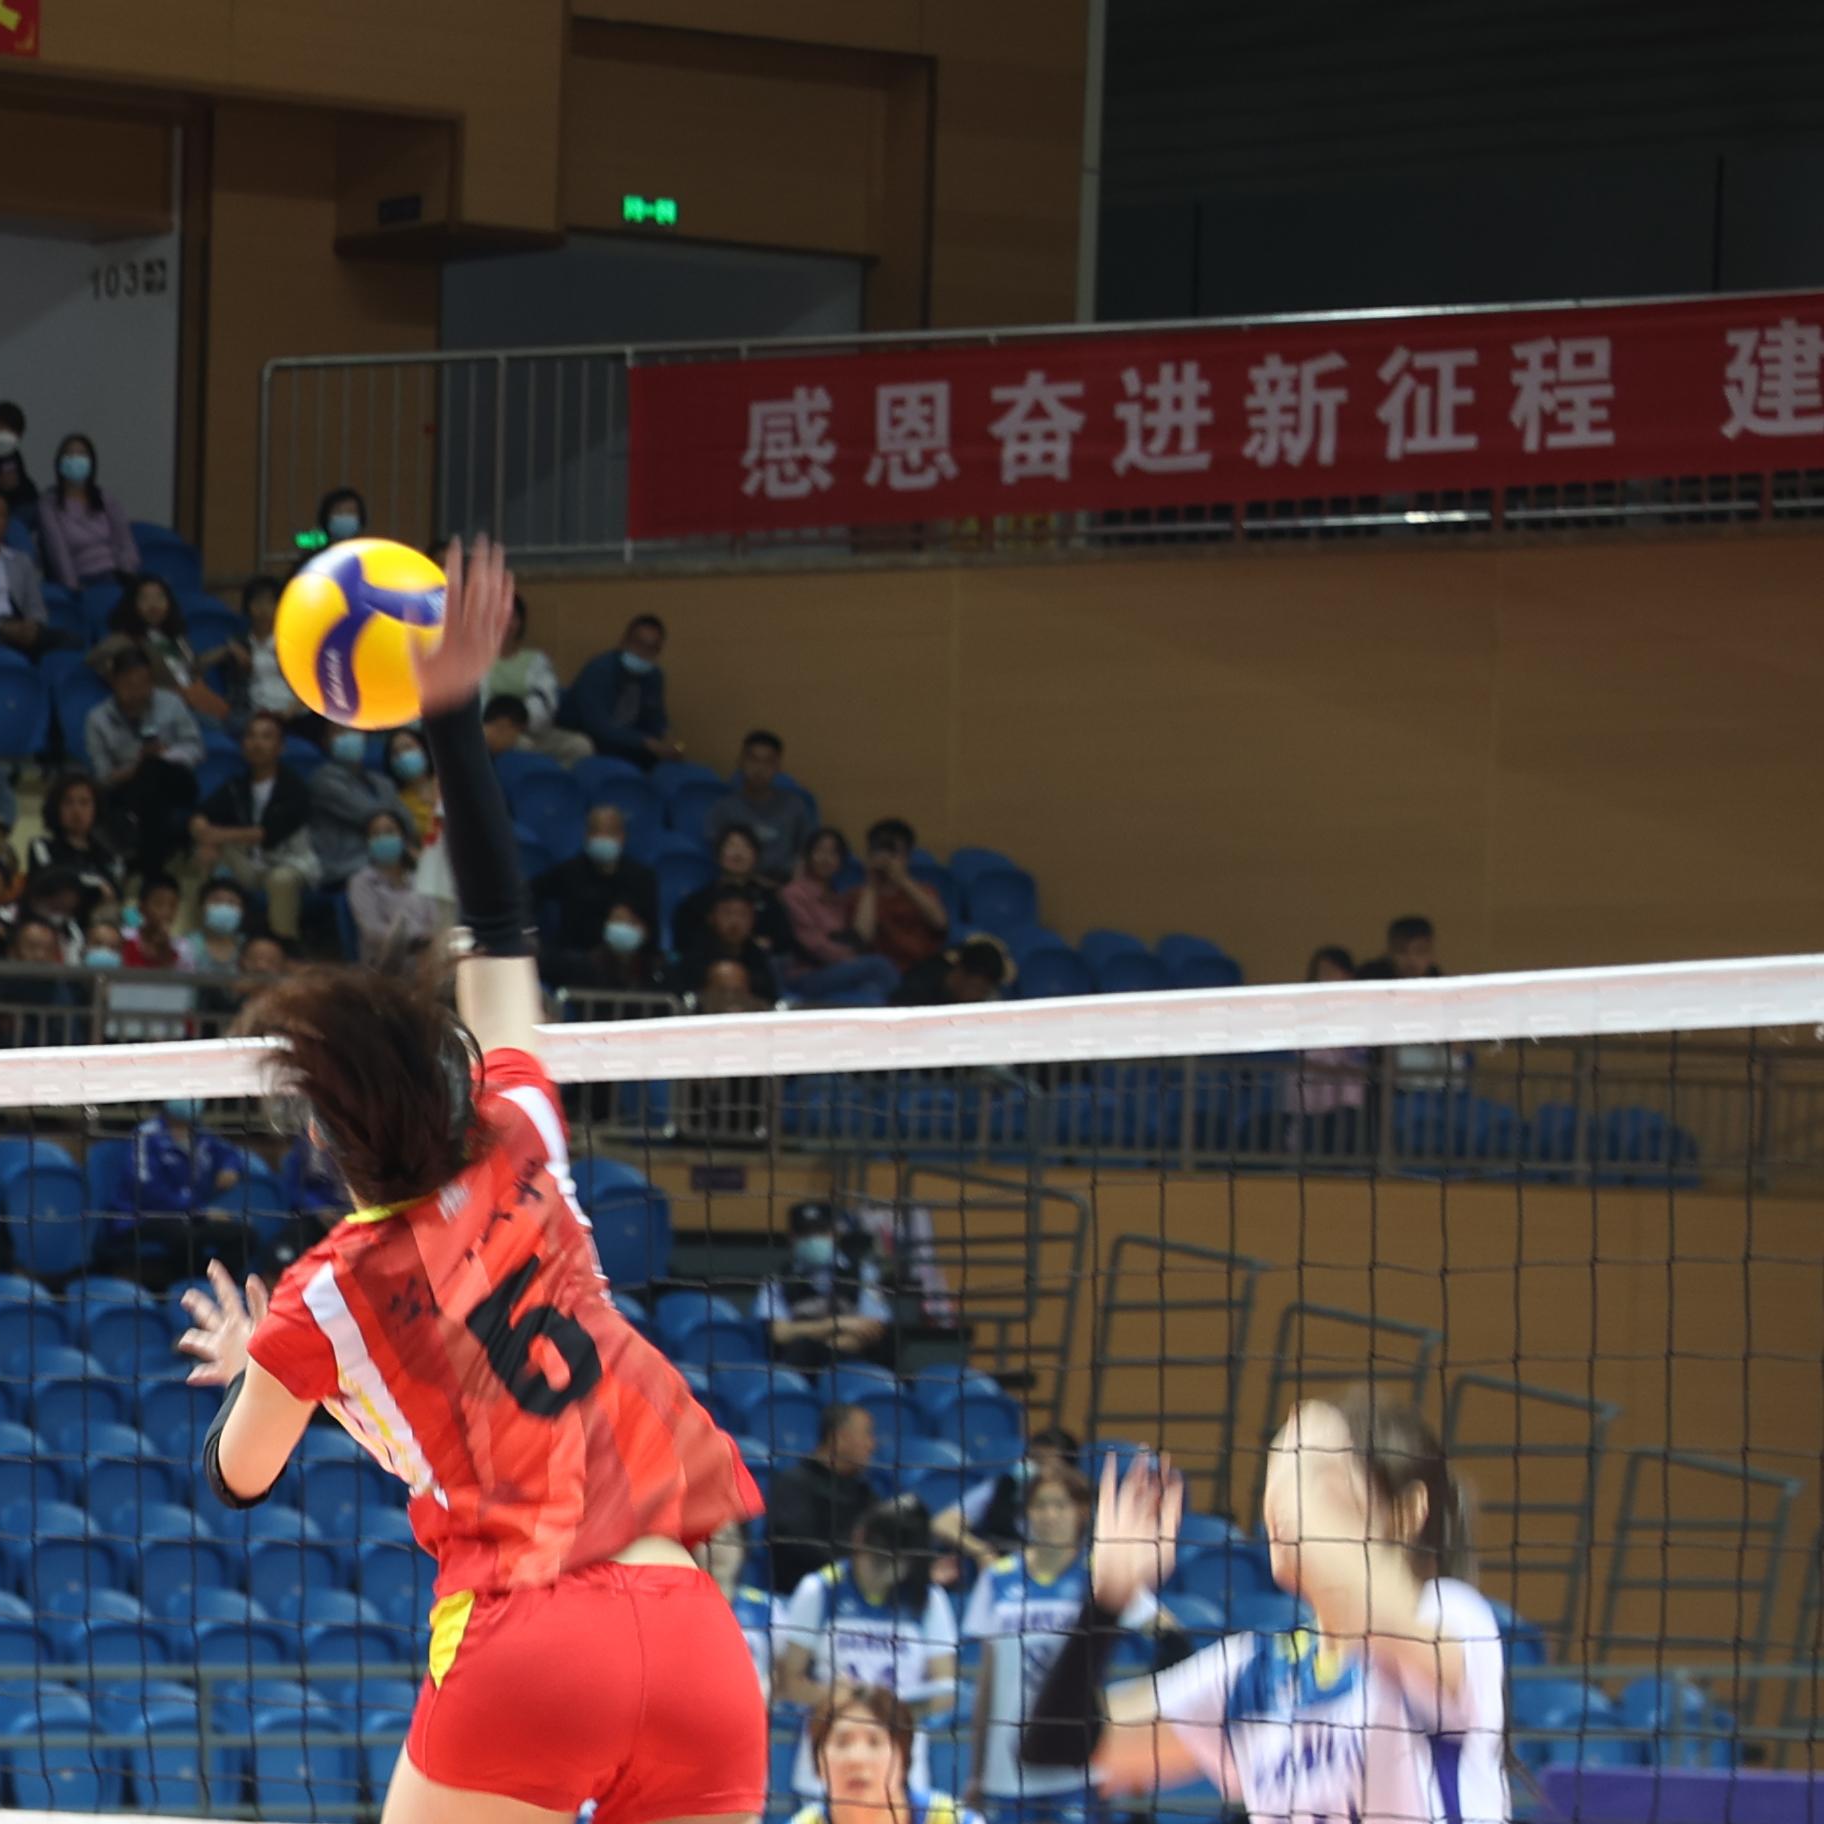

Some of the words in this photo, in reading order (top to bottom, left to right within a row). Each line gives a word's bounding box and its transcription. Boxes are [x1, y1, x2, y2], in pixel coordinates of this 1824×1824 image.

[740, 336, 1615, 500] 感恩奋进新征程
[465, 1256, 602, 1417] 6
